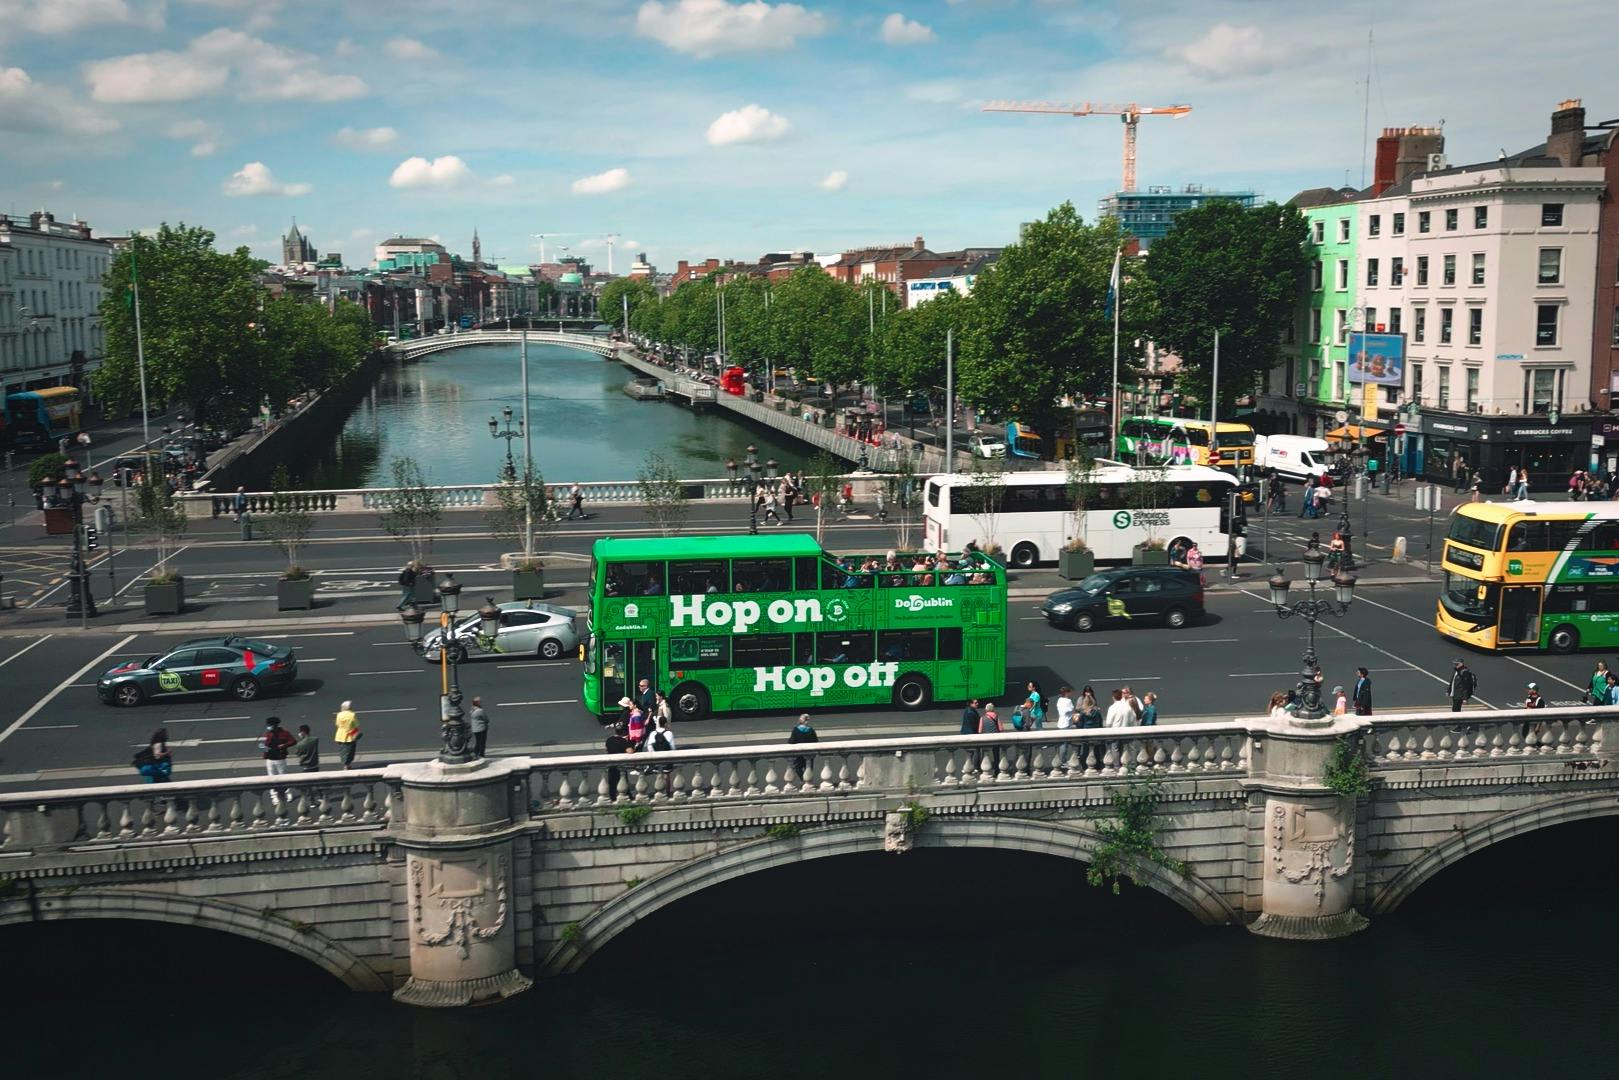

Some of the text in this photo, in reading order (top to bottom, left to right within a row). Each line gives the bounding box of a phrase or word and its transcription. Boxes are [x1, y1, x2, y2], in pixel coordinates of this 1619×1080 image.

[670, 594, 822, 632] Hop on
[895, 595, 953, 611] DoDublin
[672, 639, 699, 657] 30
[753, 660, 898, 695] Hop off
